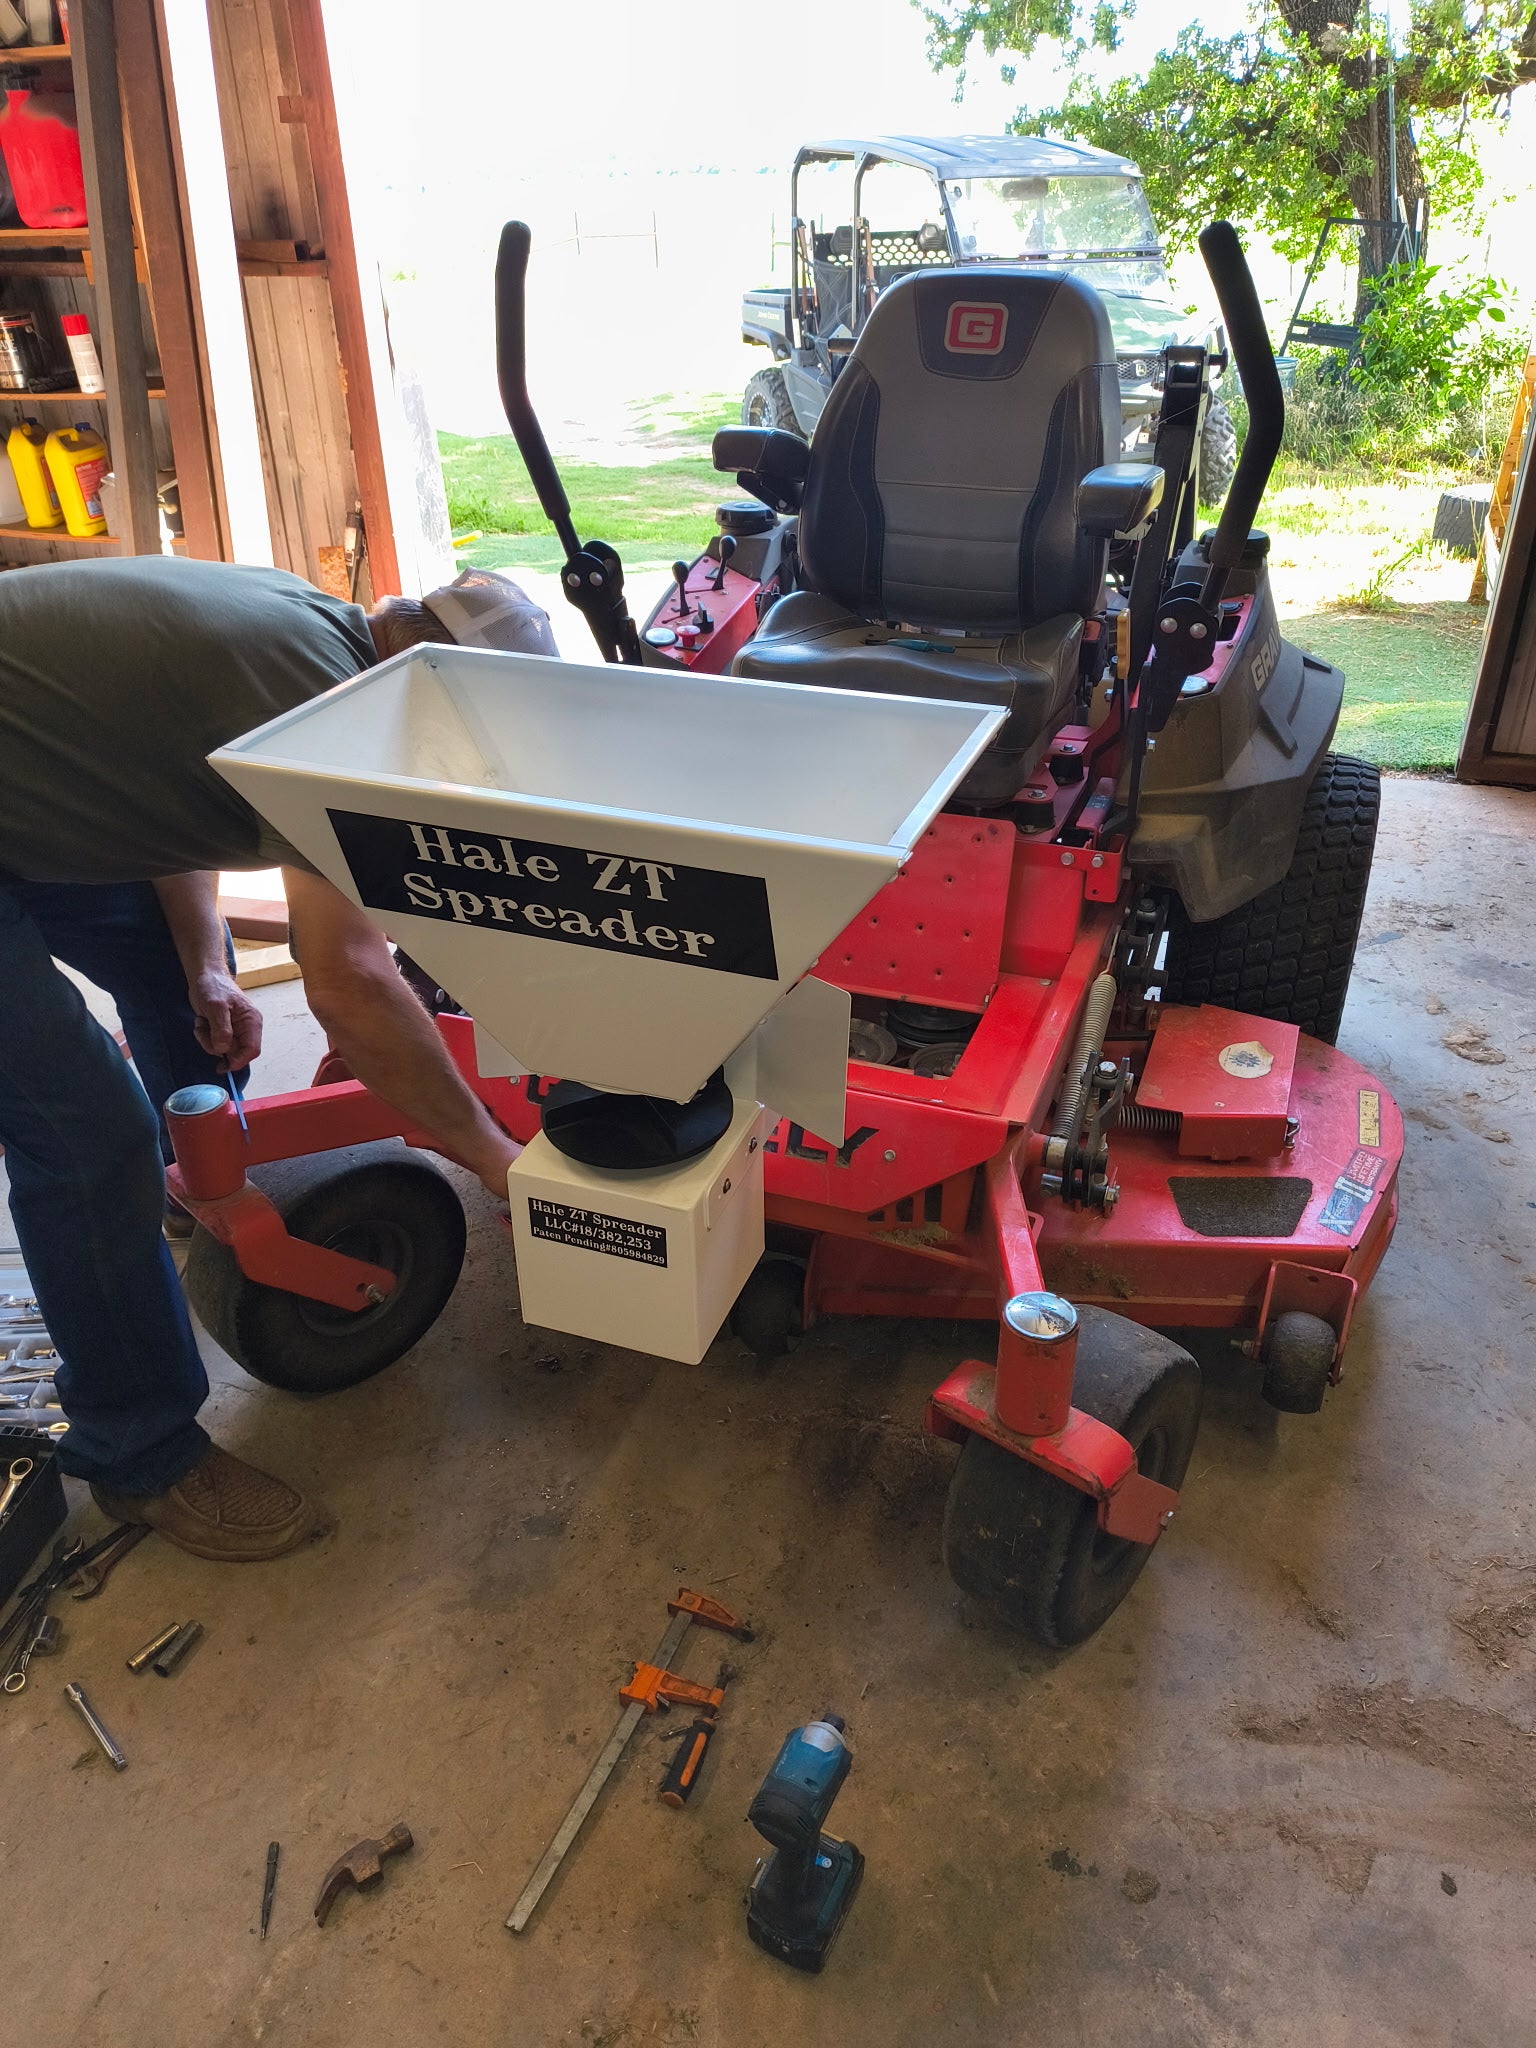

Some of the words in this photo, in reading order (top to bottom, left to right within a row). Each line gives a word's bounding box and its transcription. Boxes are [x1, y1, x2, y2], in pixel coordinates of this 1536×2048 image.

[405, 823, 560, 882] Hale
[585, 852, 676, 902] ZT
[402, 871, 716, 958] Spreader
[532, 1199, 565, 1216] Hale
[568, 1208, 588, 1222] ZT
[592, 1213, 663, 1239] Spreader
